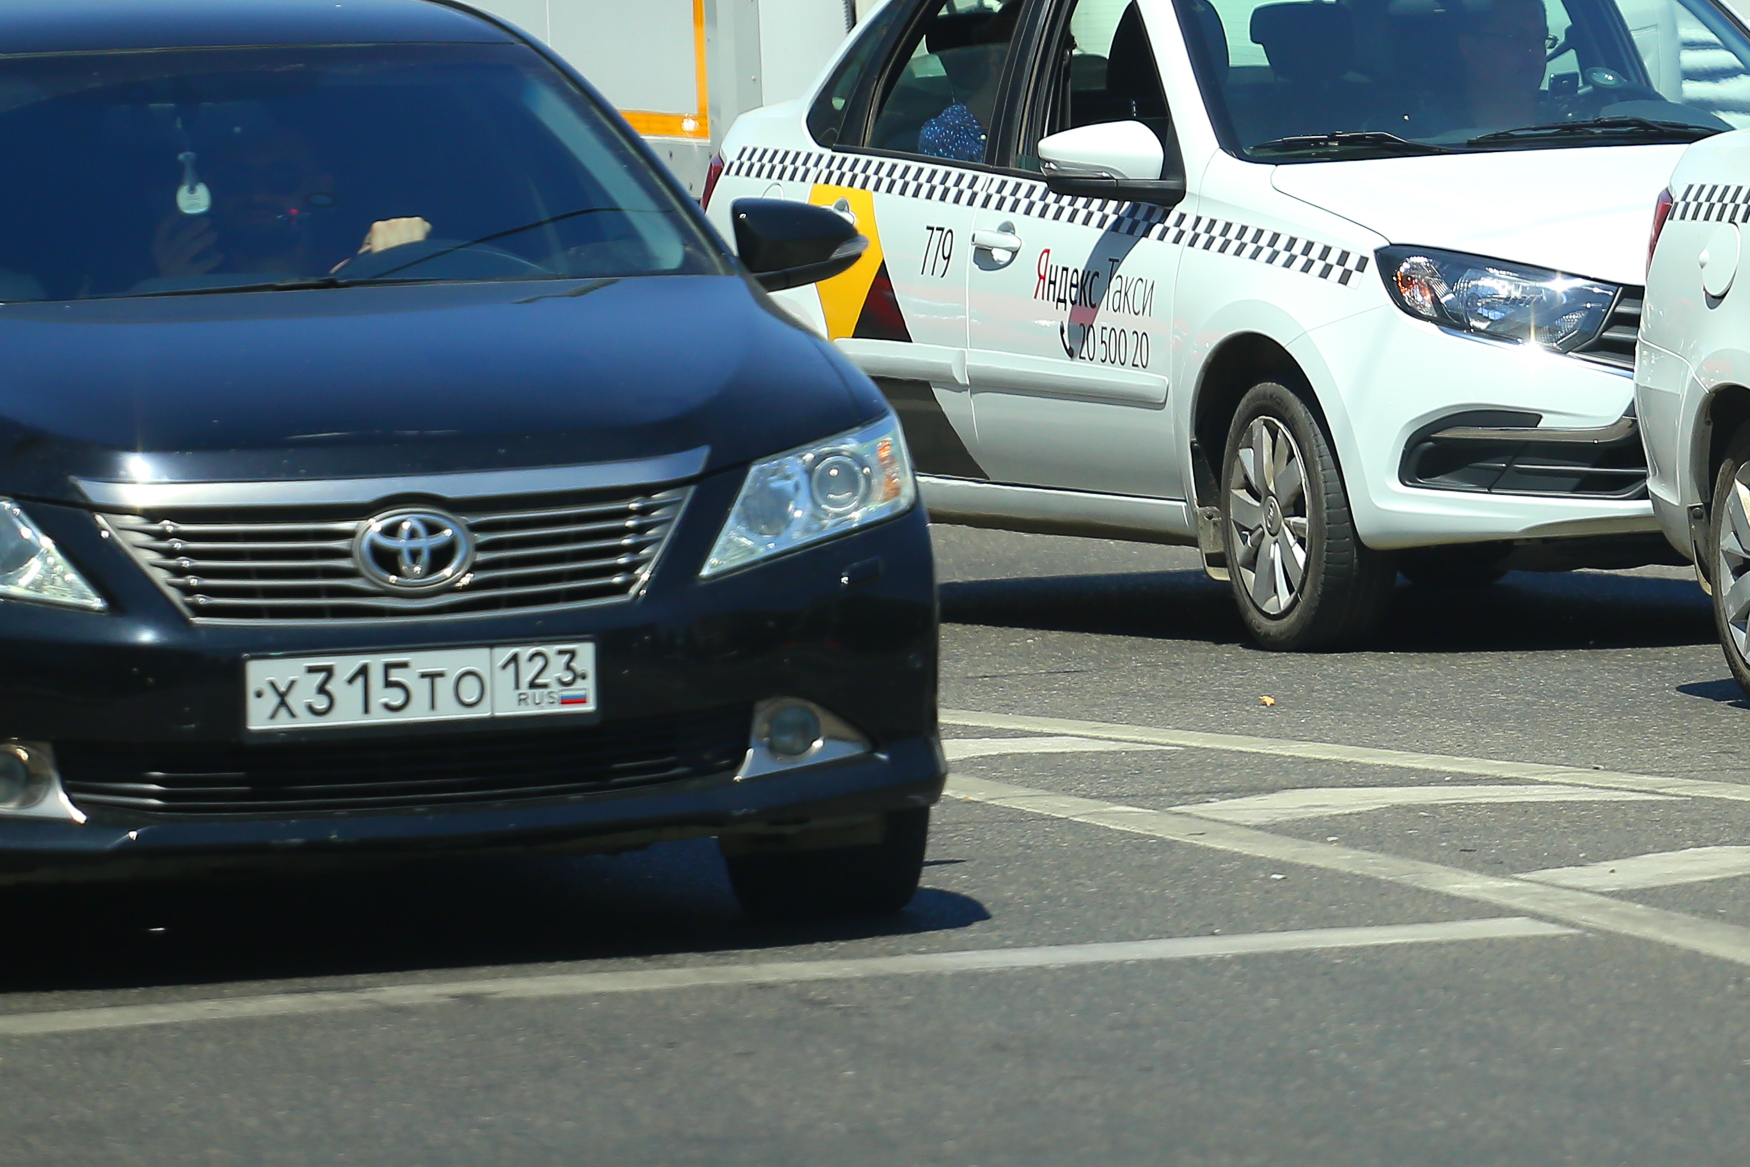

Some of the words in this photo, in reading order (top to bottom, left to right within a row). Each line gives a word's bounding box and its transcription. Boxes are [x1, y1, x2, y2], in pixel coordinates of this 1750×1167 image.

[920, 226, 954, 278] 779
[1033, 248, 1100, 311] Яндекс
[1104, 258, 1156, 318] Такси
[1079, 323, 1096, 362] 20
[1100, 326, 1128, 368] 500
[1131, 331, 1150, 369] 20
[498, 646, 580, 691] 123
[517, 691, 557, 706] RUS
